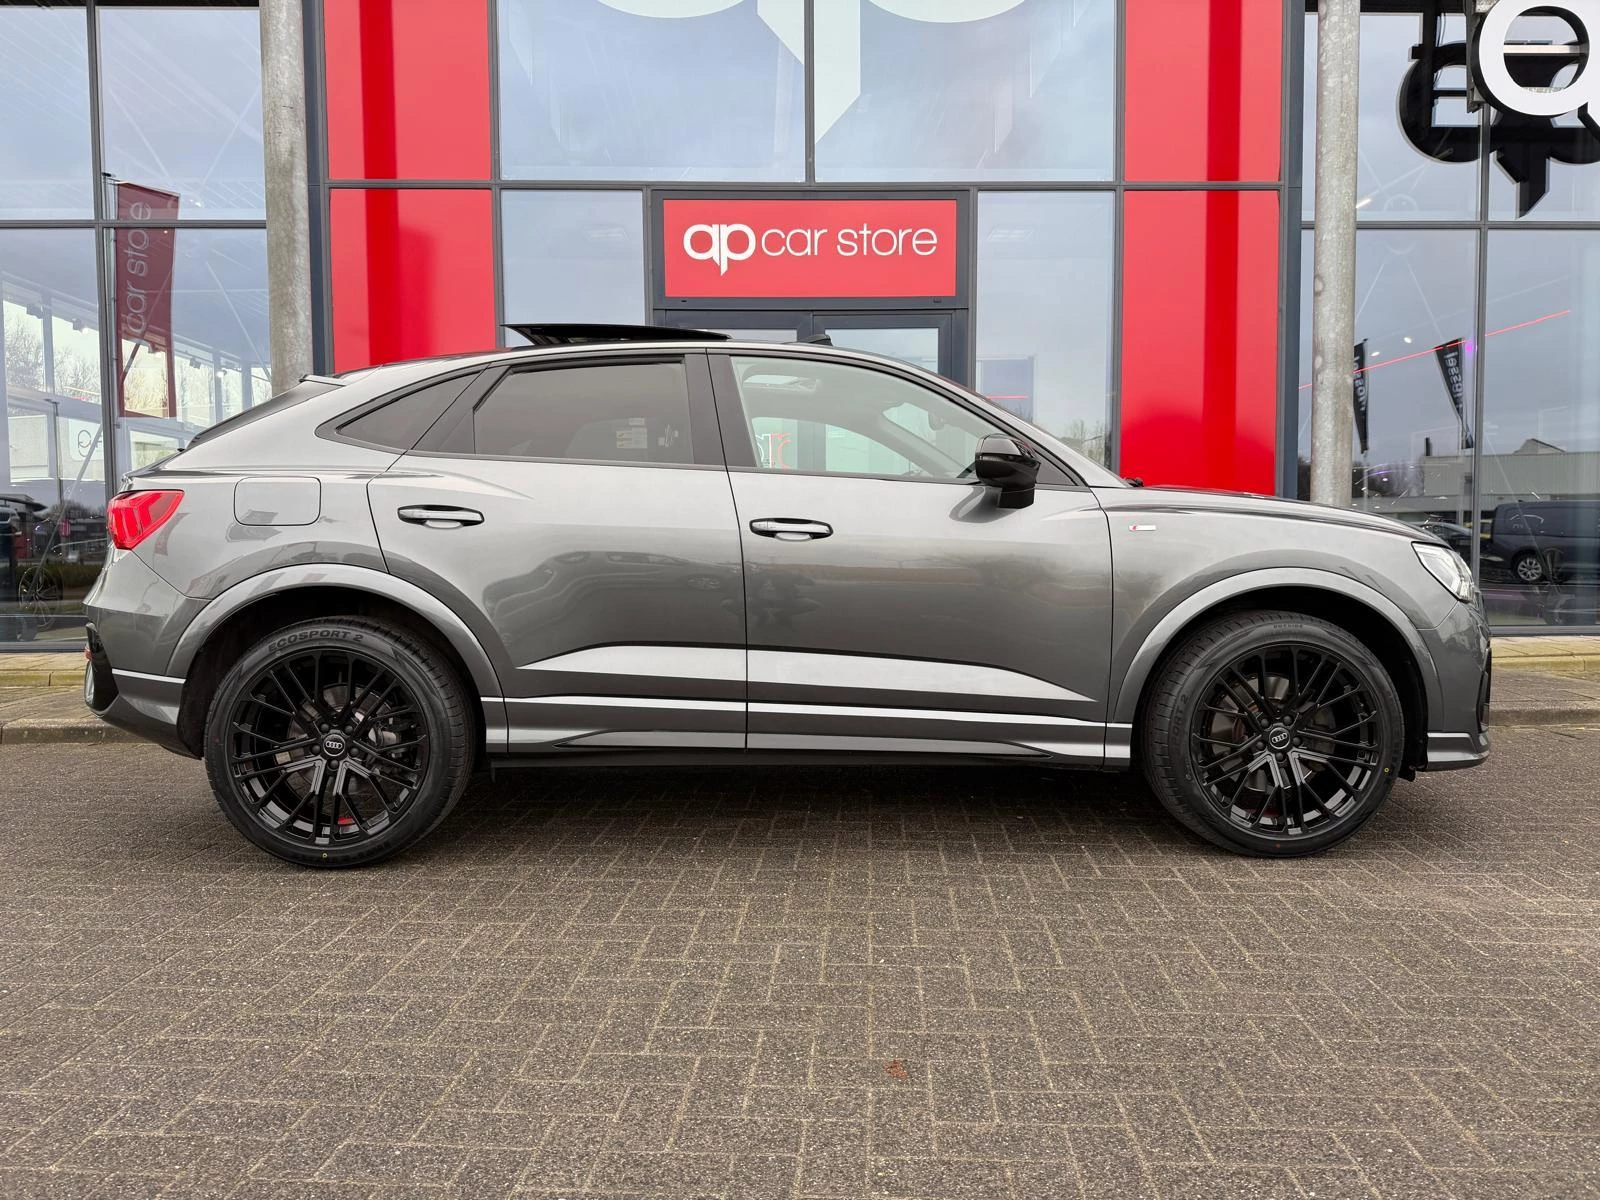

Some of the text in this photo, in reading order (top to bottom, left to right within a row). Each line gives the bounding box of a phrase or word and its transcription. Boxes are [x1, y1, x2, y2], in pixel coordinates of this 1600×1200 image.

[124, 201, 151, 335] car stoe
[683, 223, 938, 277] ap car store
[268, 629, 365, 652] ECOSPORT 2
